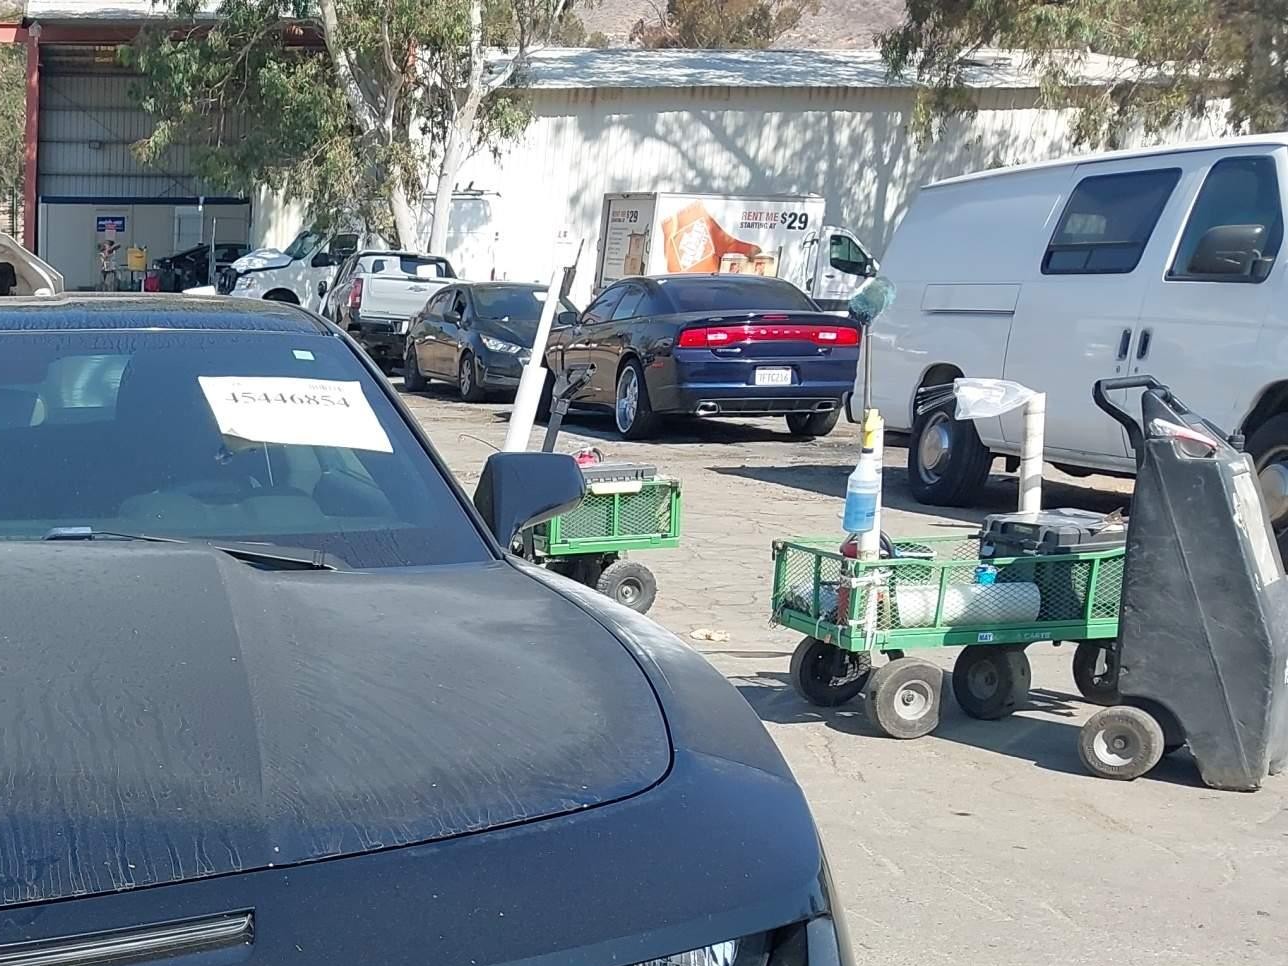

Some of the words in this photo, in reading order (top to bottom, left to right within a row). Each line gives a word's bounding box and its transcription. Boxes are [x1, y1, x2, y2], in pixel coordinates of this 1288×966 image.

[626, 210, 638, 223] $29
[741, 211, 763, 222] RENT
[765, 211, 779, 222] ME
[780, 211, 809, 231] $29
[224, 391, 351, 408] 45446854
